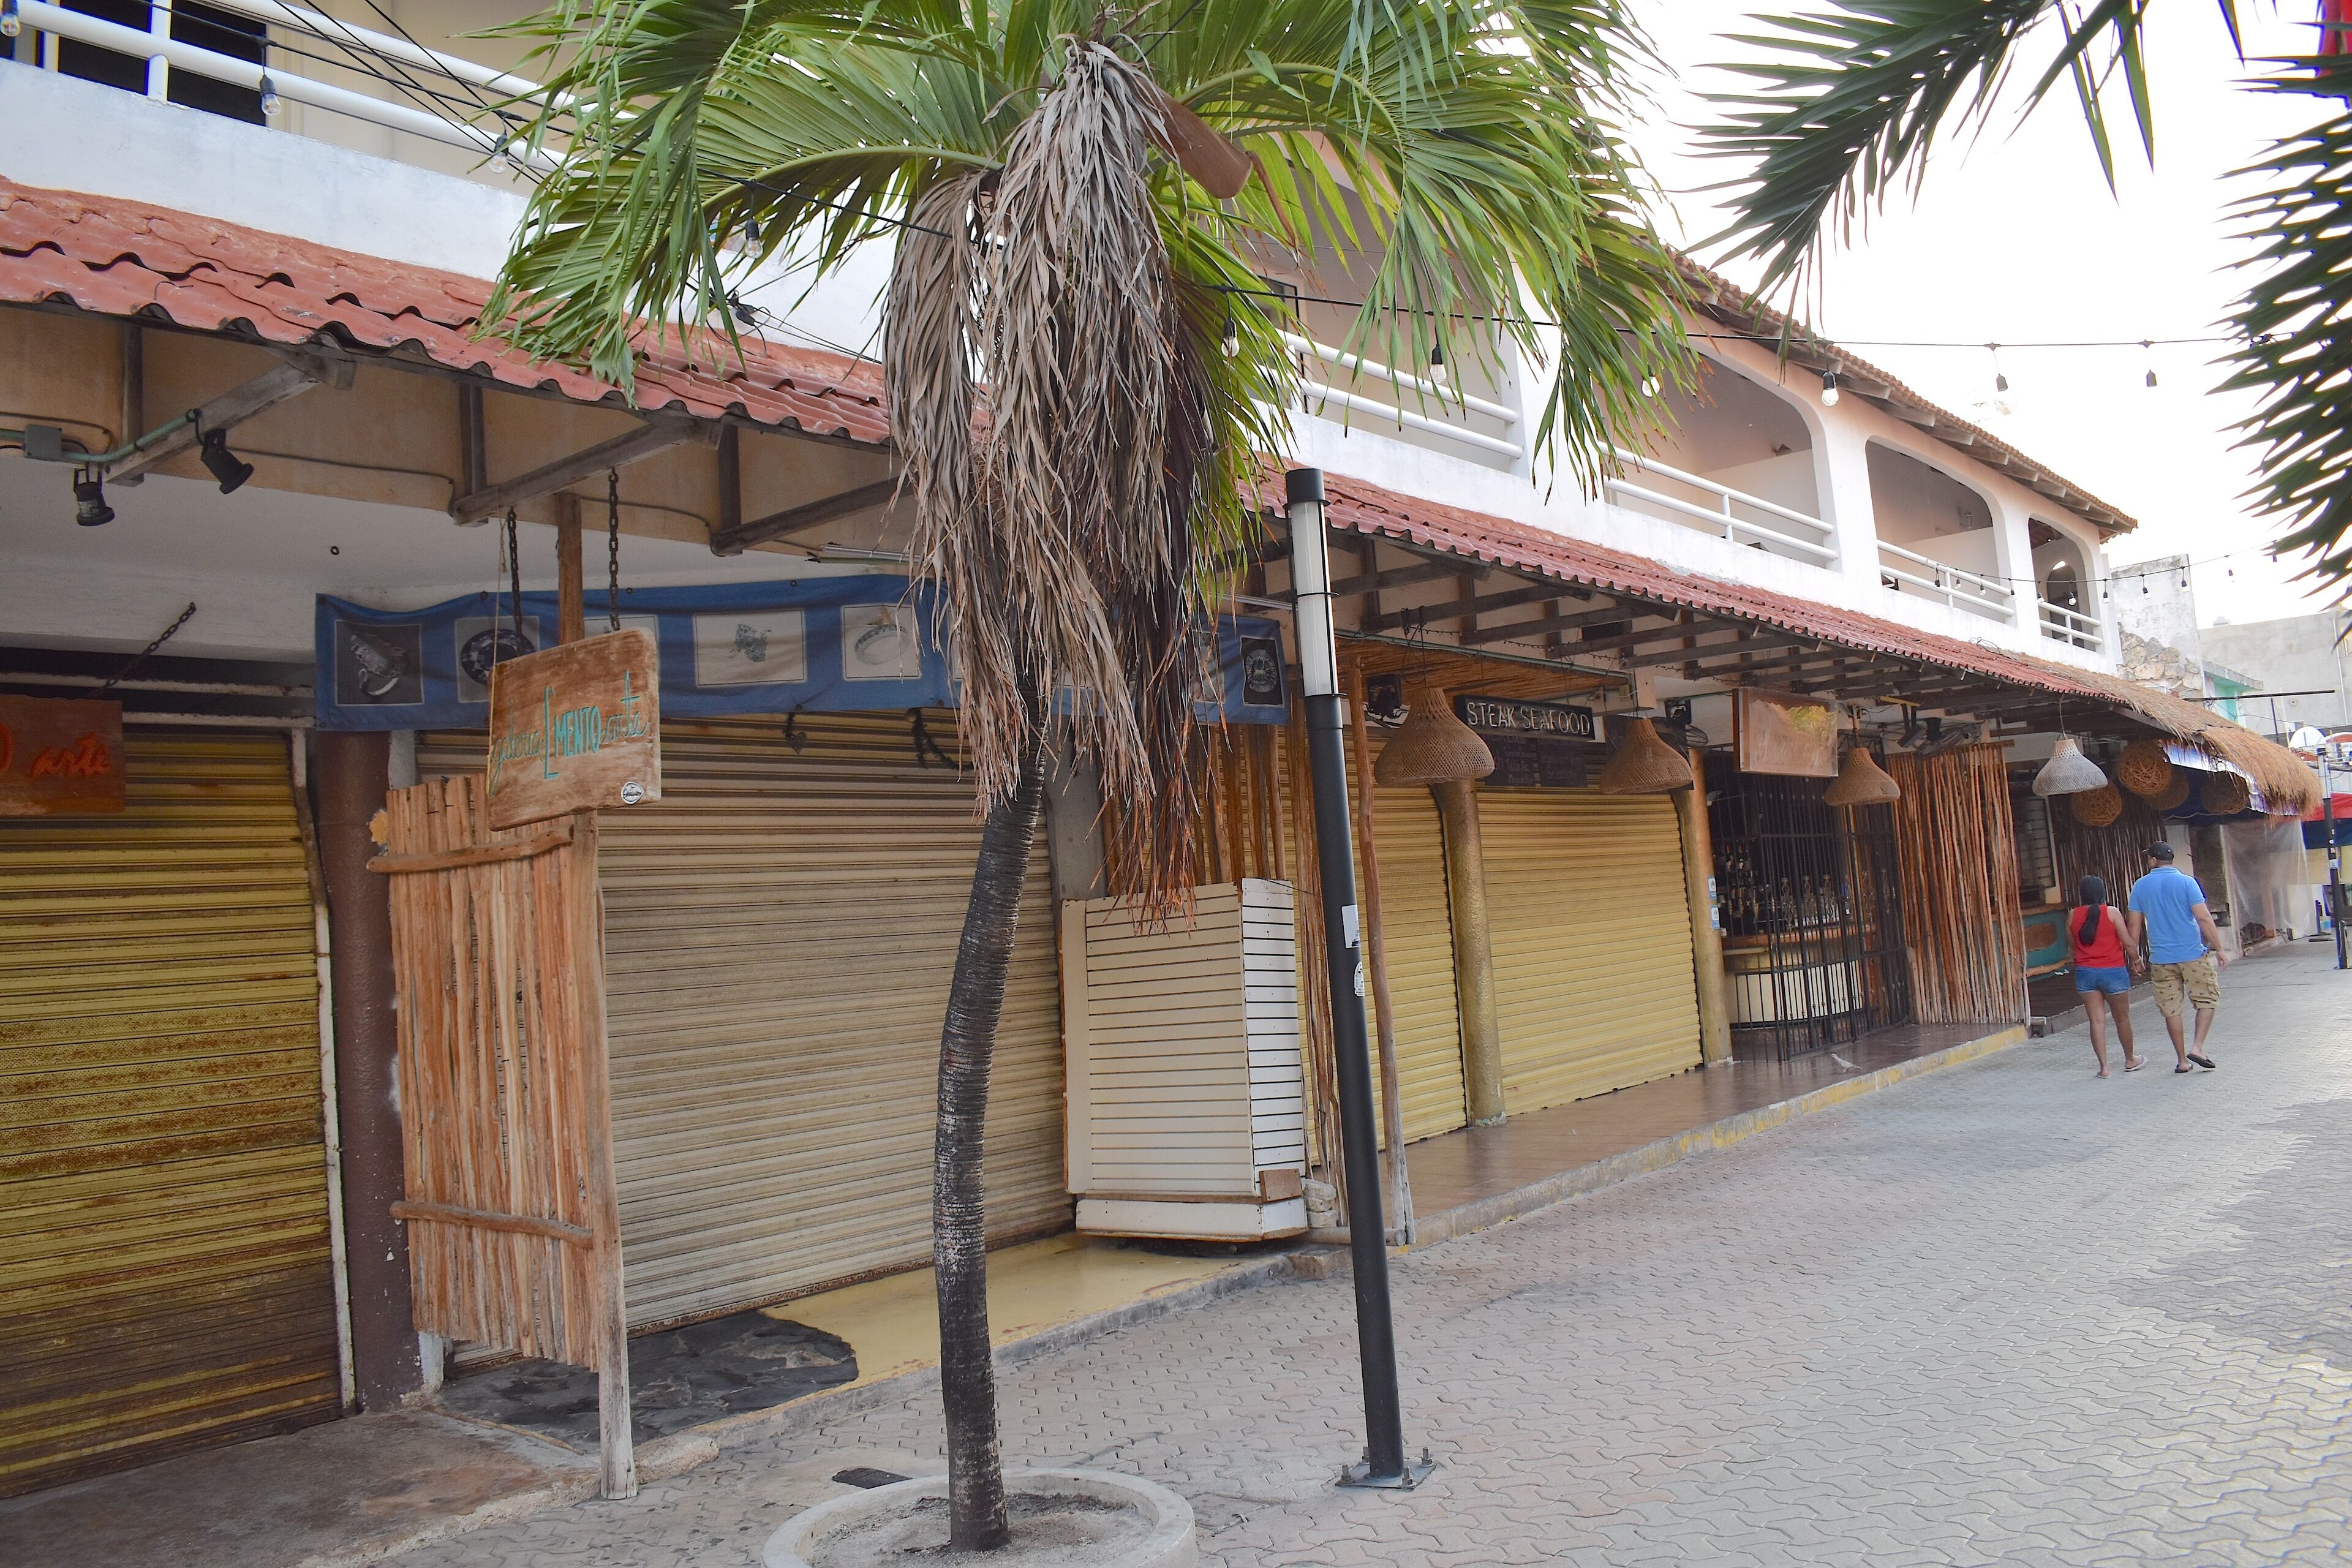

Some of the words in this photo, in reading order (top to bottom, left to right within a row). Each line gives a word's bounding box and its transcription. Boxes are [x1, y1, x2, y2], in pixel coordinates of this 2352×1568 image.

[601, 669, 647, 743] arte
[1468, 702, 1517, 728] STEAK
[1520, 706, 1590, 735] SEAFOOD
